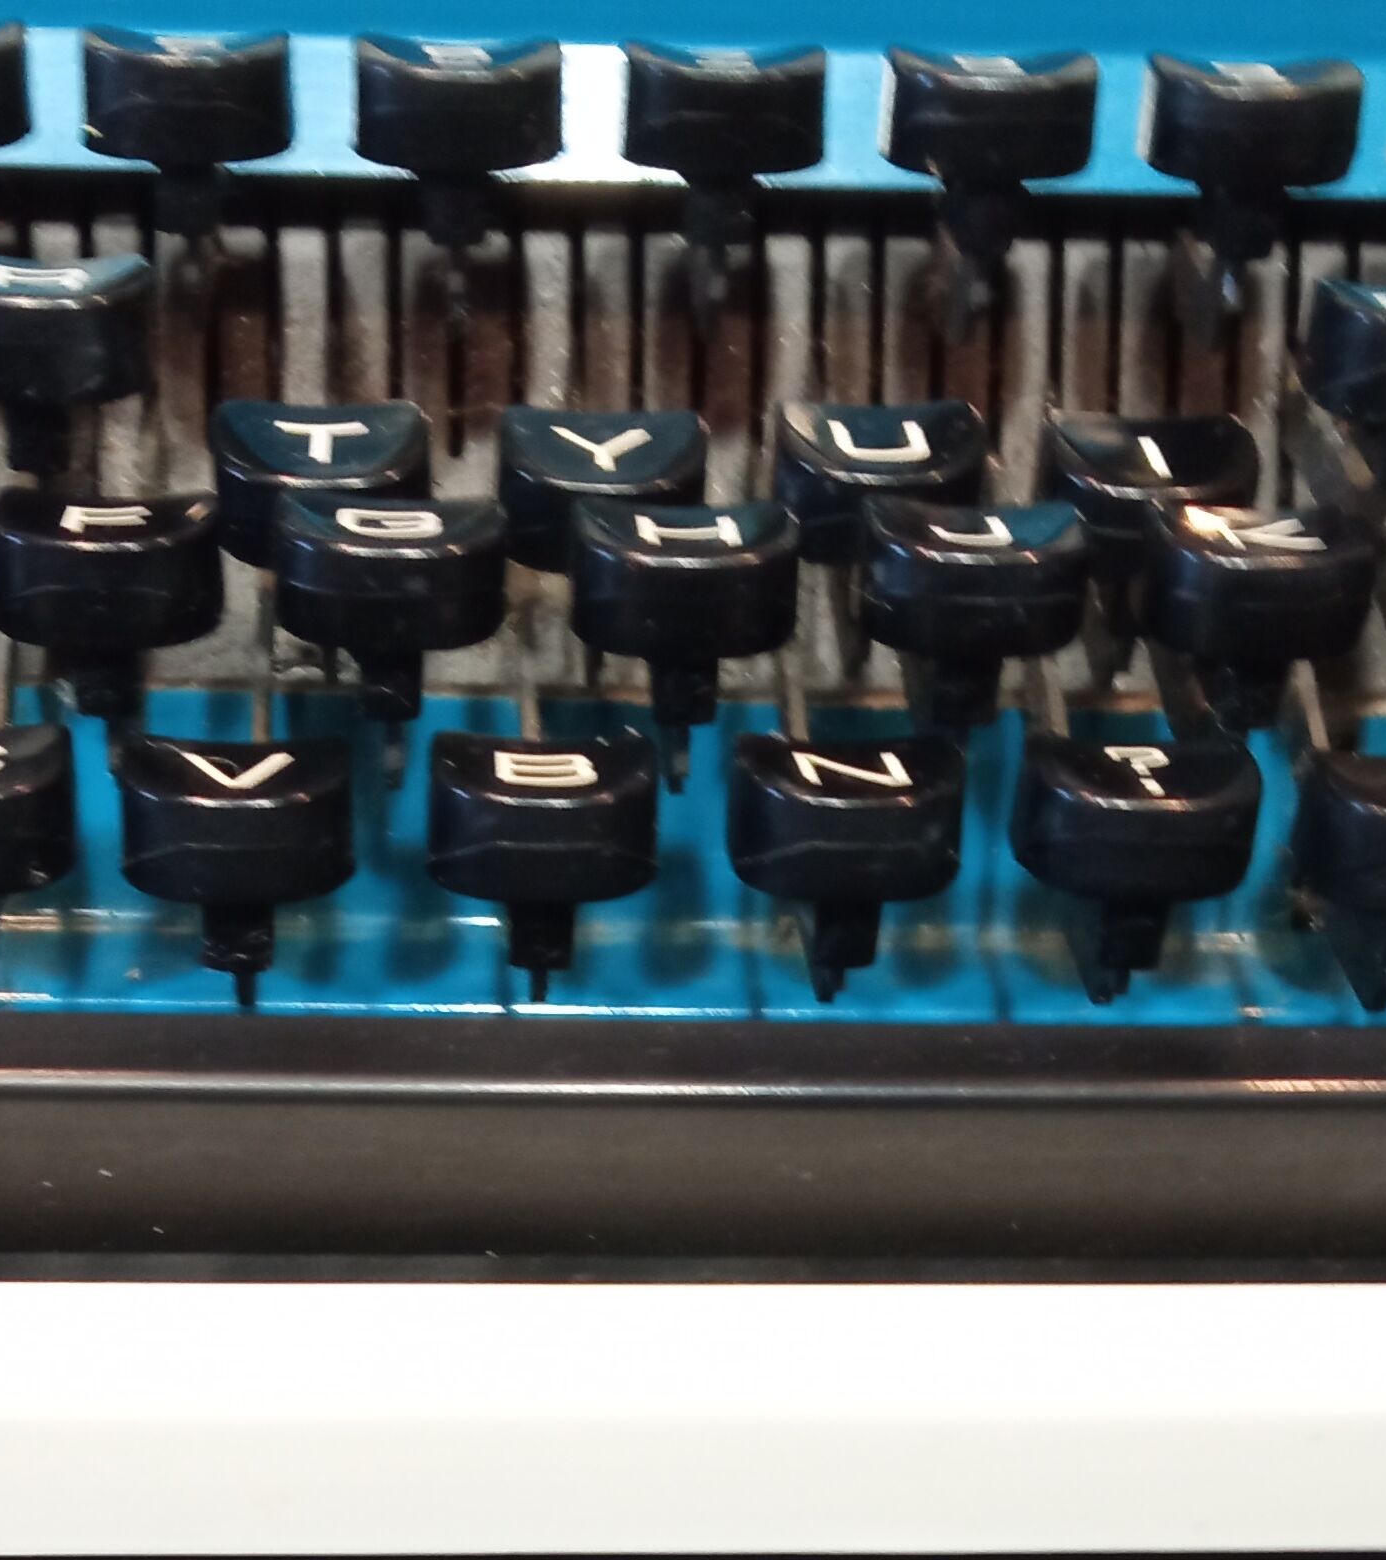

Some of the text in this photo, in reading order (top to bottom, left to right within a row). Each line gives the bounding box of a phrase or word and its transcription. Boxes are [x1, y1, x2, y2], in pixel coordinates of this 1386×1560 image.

[274, 421, 369, 464] T
[550, 426, 653, 471] Y
[827, 420, 931, 462] U
[60, 505, 153, 534] F
[336, 508, 444, 539] G
[635, 515, 743, 547] H
[928, 516, 1013, 547] J
[183, 752, 296, 790] V
[494, 750, 599, 787] B
[790, 751, 913, 787] N
